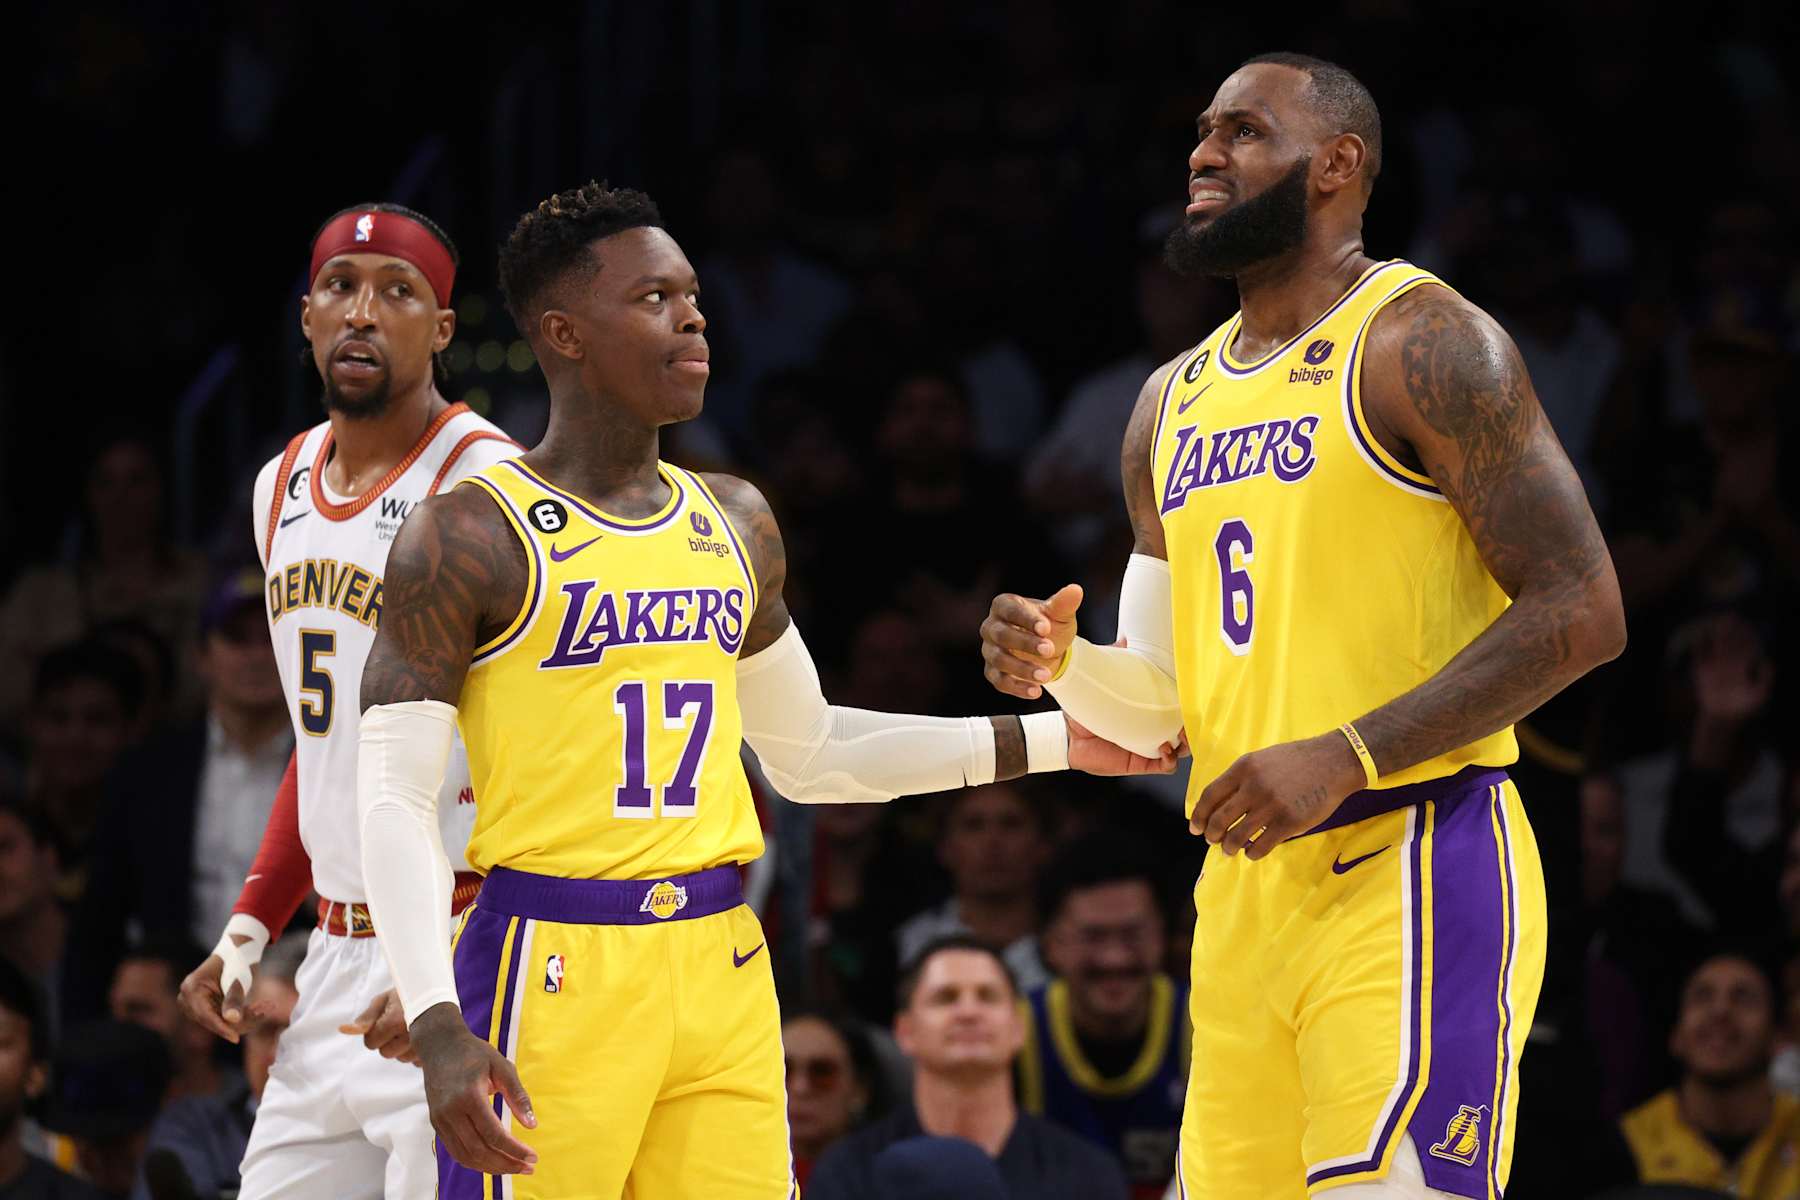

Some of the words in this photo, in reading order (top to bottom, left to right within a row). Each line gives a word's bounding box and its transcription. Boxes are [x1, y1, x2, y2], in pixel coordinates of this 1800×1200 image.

[1288, 368, 1334, 386] bibigo
[1160, 415, 1320, 516] LAKERS
[534, 503, 562, 531] 6
[687, 537, 730, 558] bibigo
[269, 558, 384, 631] DENVER
[537, 579, 746, 671] LAKERS
[1212, 516, 1255, 656] 6
[298, 628, 337, 738] 5
[612, 680, 715, 819] 17
[639, 886, 688, 912] LAKERS
